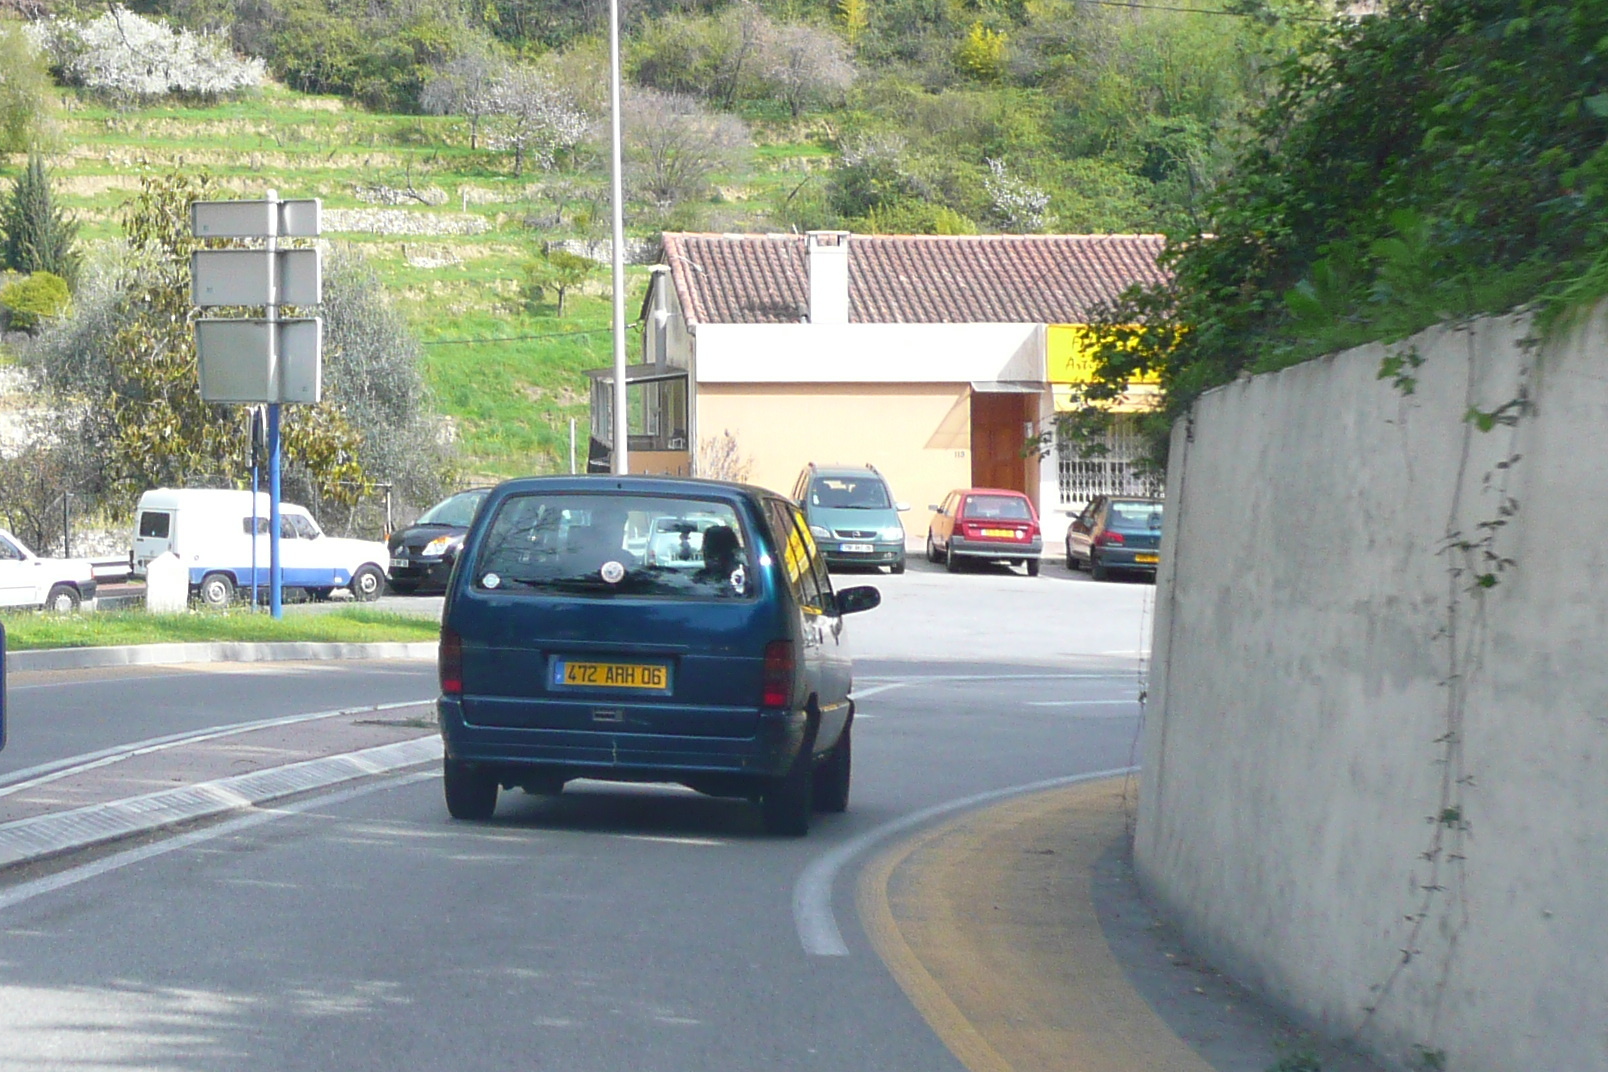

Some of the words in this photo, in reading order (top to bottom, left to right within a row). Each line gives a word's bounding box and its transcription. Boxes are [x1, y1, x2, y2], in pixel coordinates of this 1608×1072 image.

[568, 665, 597, 682] 472
[605, 666, 635, 684] ARH
[641, 668, 662, 685] 06
